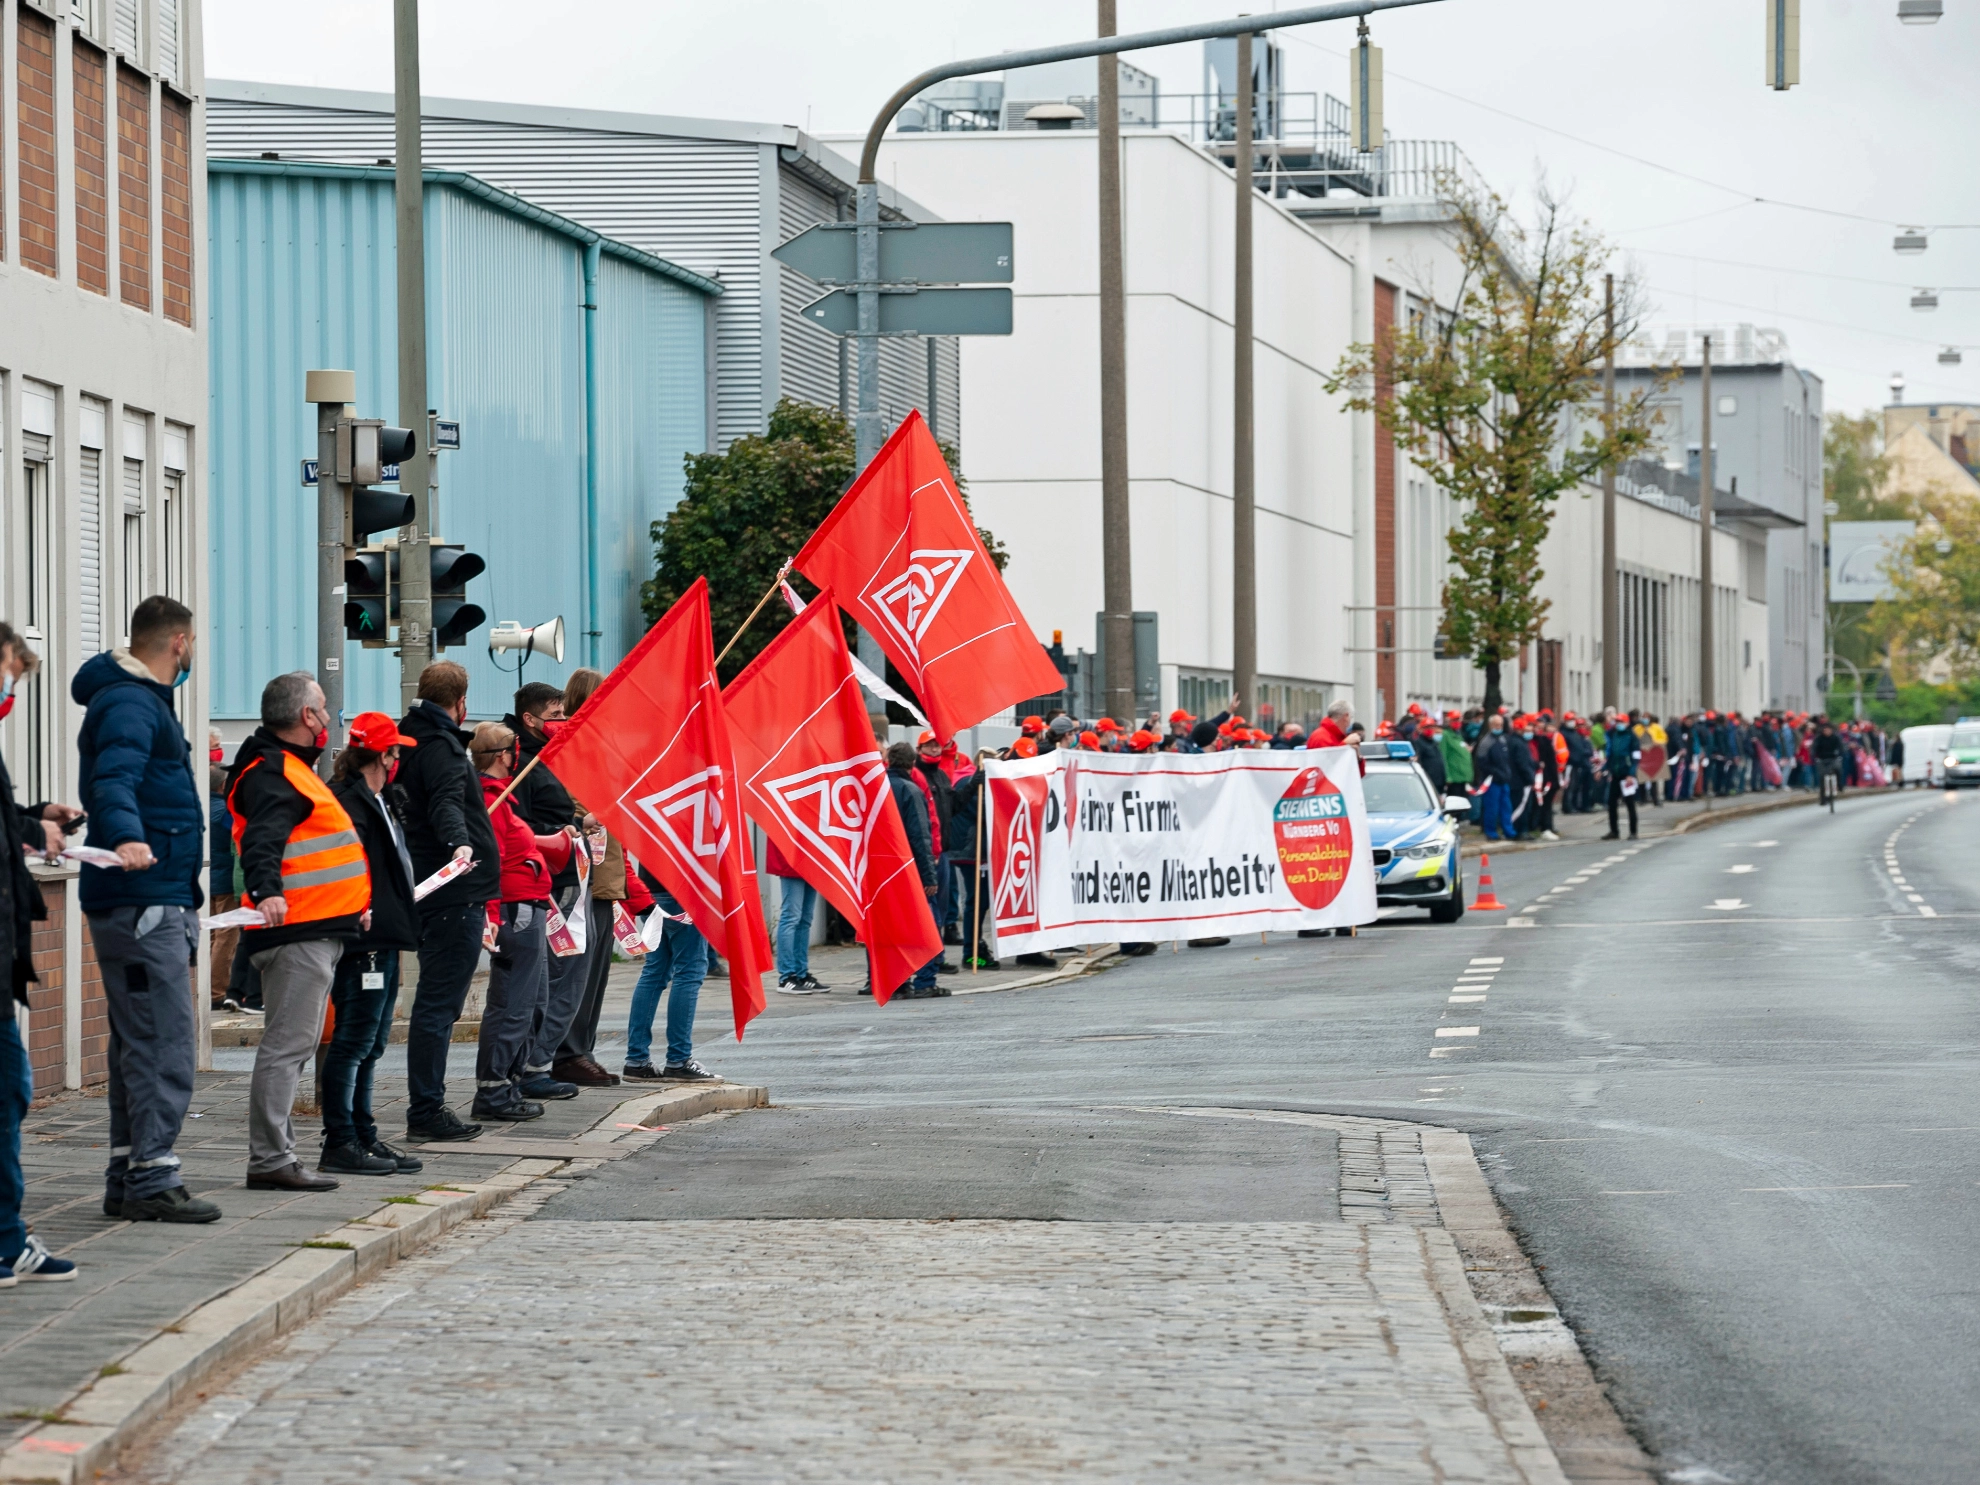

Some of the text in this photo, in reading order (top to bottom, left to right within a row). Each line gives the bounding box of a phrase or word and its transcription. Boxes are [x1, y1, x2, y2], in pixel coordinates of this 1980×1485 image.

[1122, 790, 1181, 833] Firma
[1277, 796, 1342, 820] SIEMENS
[1278, 843, 1350, 863] Personalabbau
[1103, 860, 1151, 904] seine
[1160, 853, 1276, 902] Mitarbeitr
[1287, 870, 1308, 884] nein
